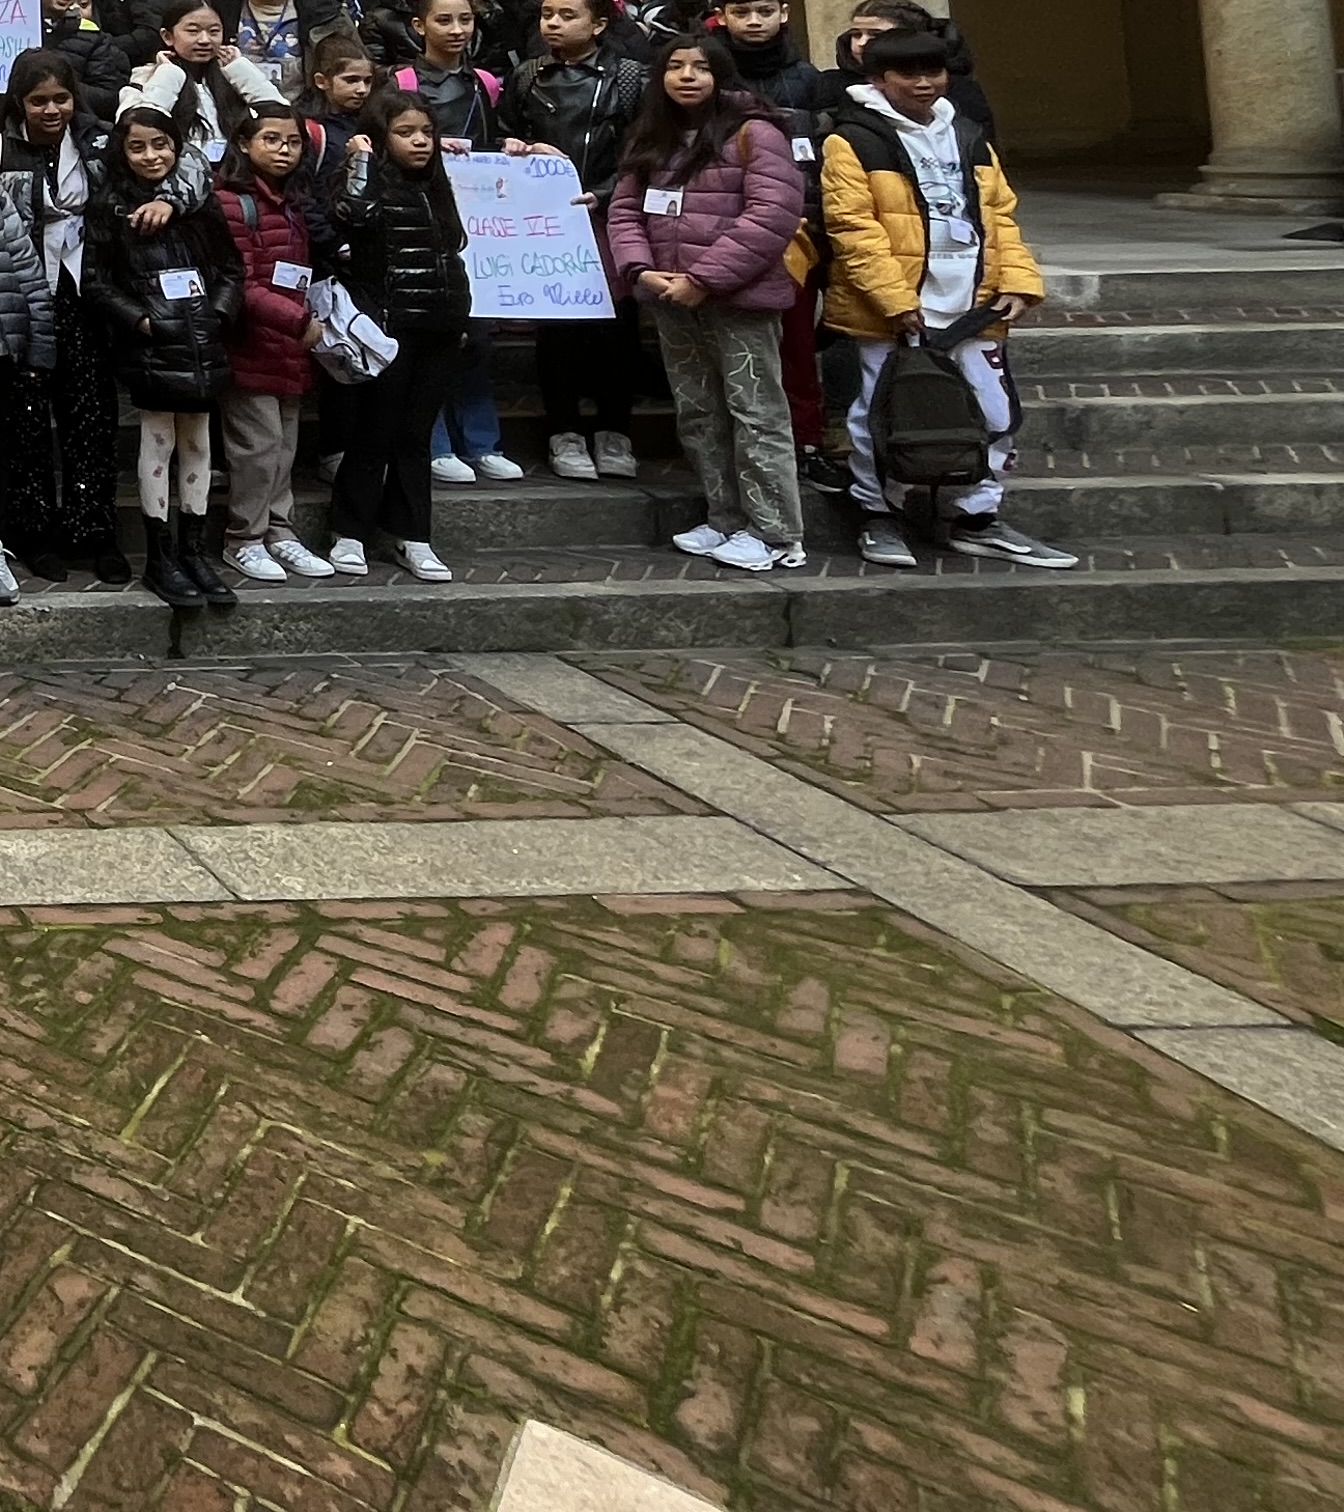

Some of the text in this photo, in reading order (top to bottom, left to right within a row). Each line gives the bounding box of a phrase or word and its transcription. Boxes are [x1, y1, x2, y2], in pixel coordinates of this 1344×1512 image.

[467, 216, 518, 238] CLASSE
[473, 244, 601, 279] LUIGI CADORNA
